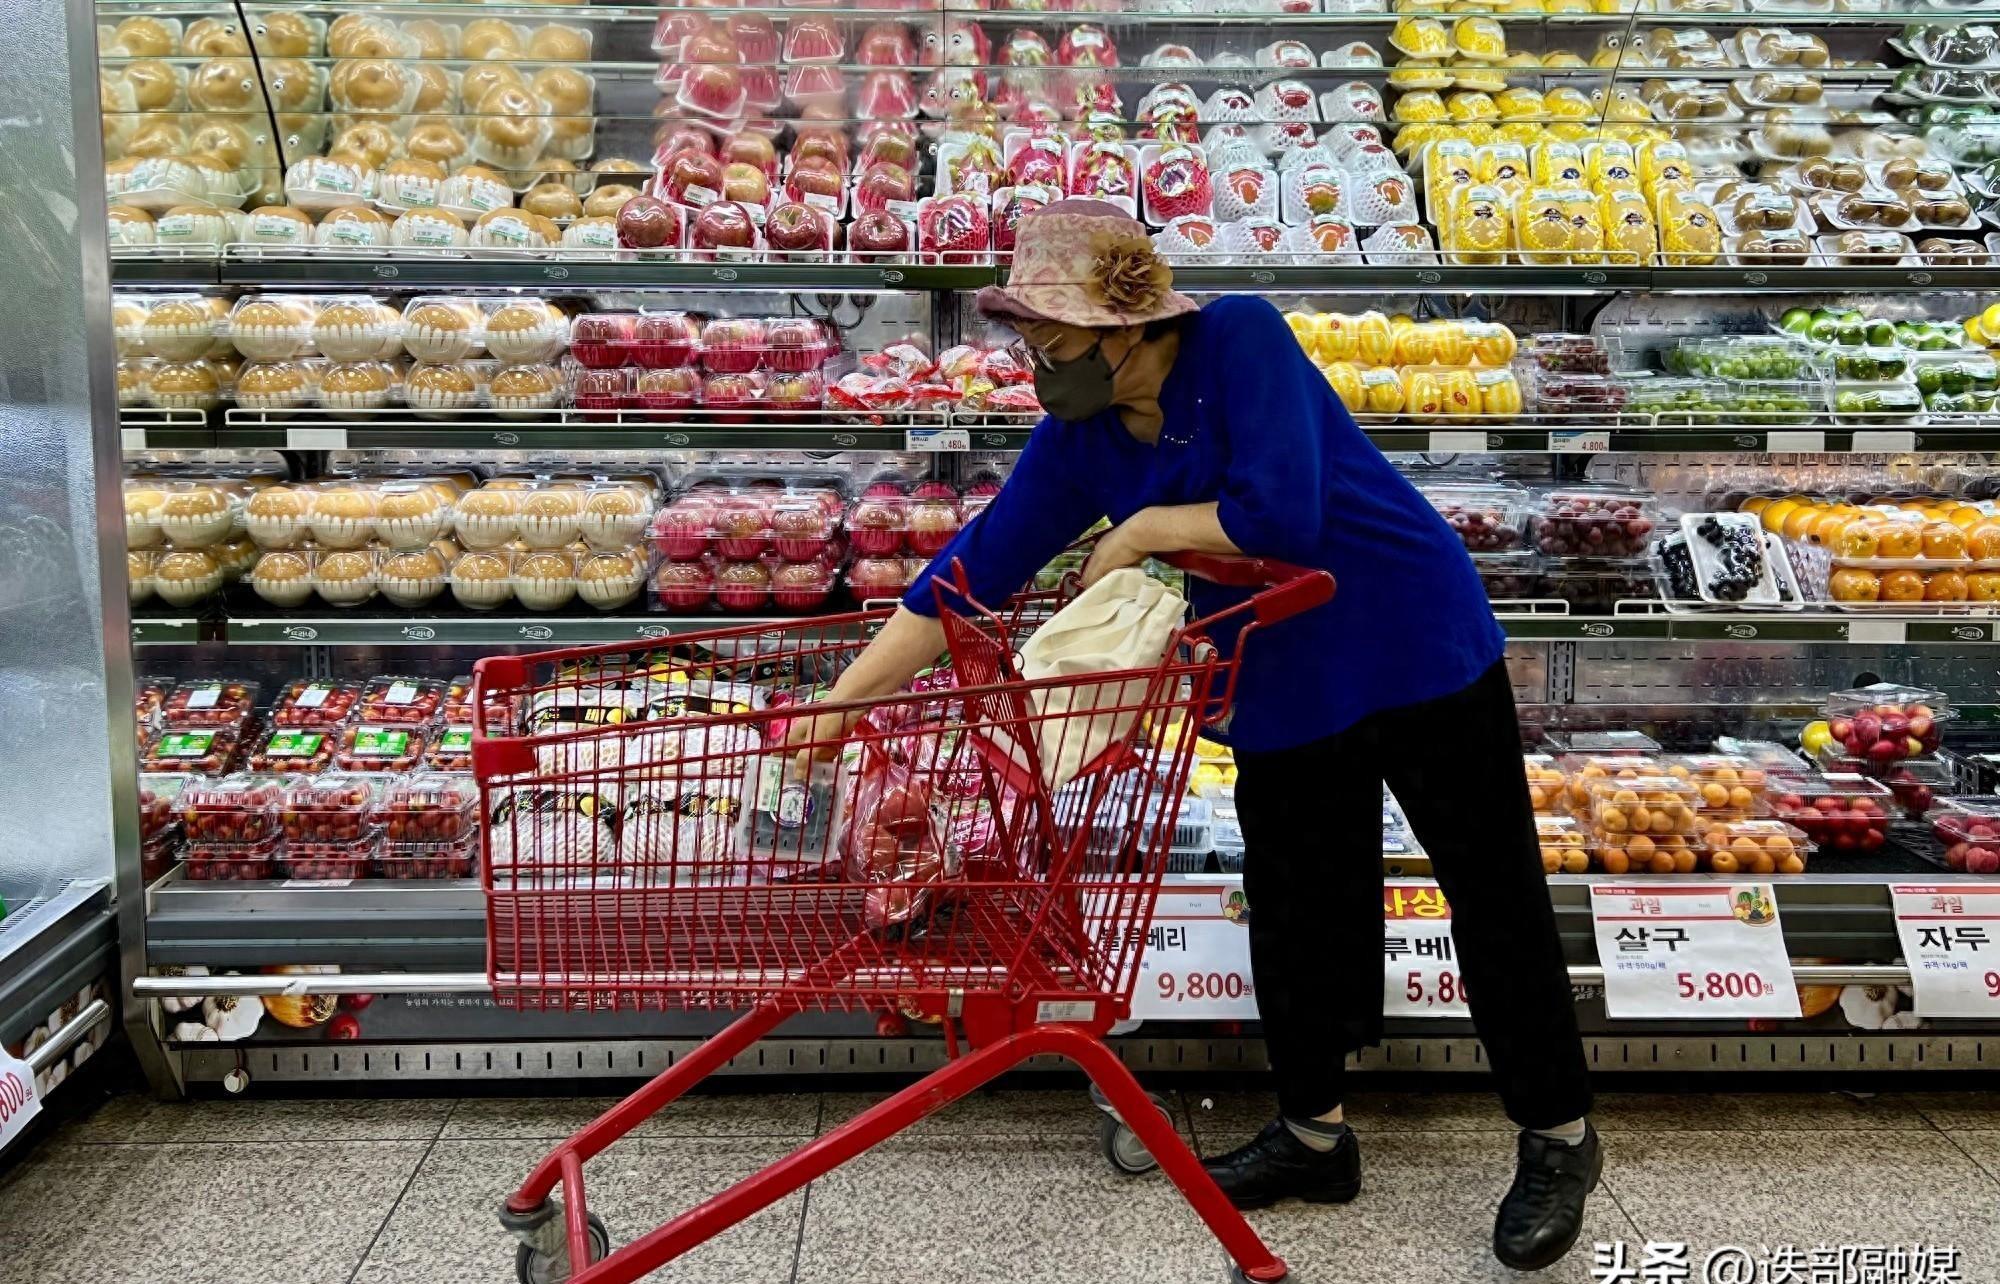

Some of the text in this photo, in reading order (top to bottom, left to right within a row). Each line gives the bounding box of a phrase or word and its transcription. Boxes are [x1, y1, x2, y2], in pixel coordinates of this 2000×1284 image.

[1630, 897, 1662, 914] 과일
[1931, 896, 1964, 913] 과일
[1614, 927, 1690, 952] 살구
[1917, 926, 1990, 951] 자두
